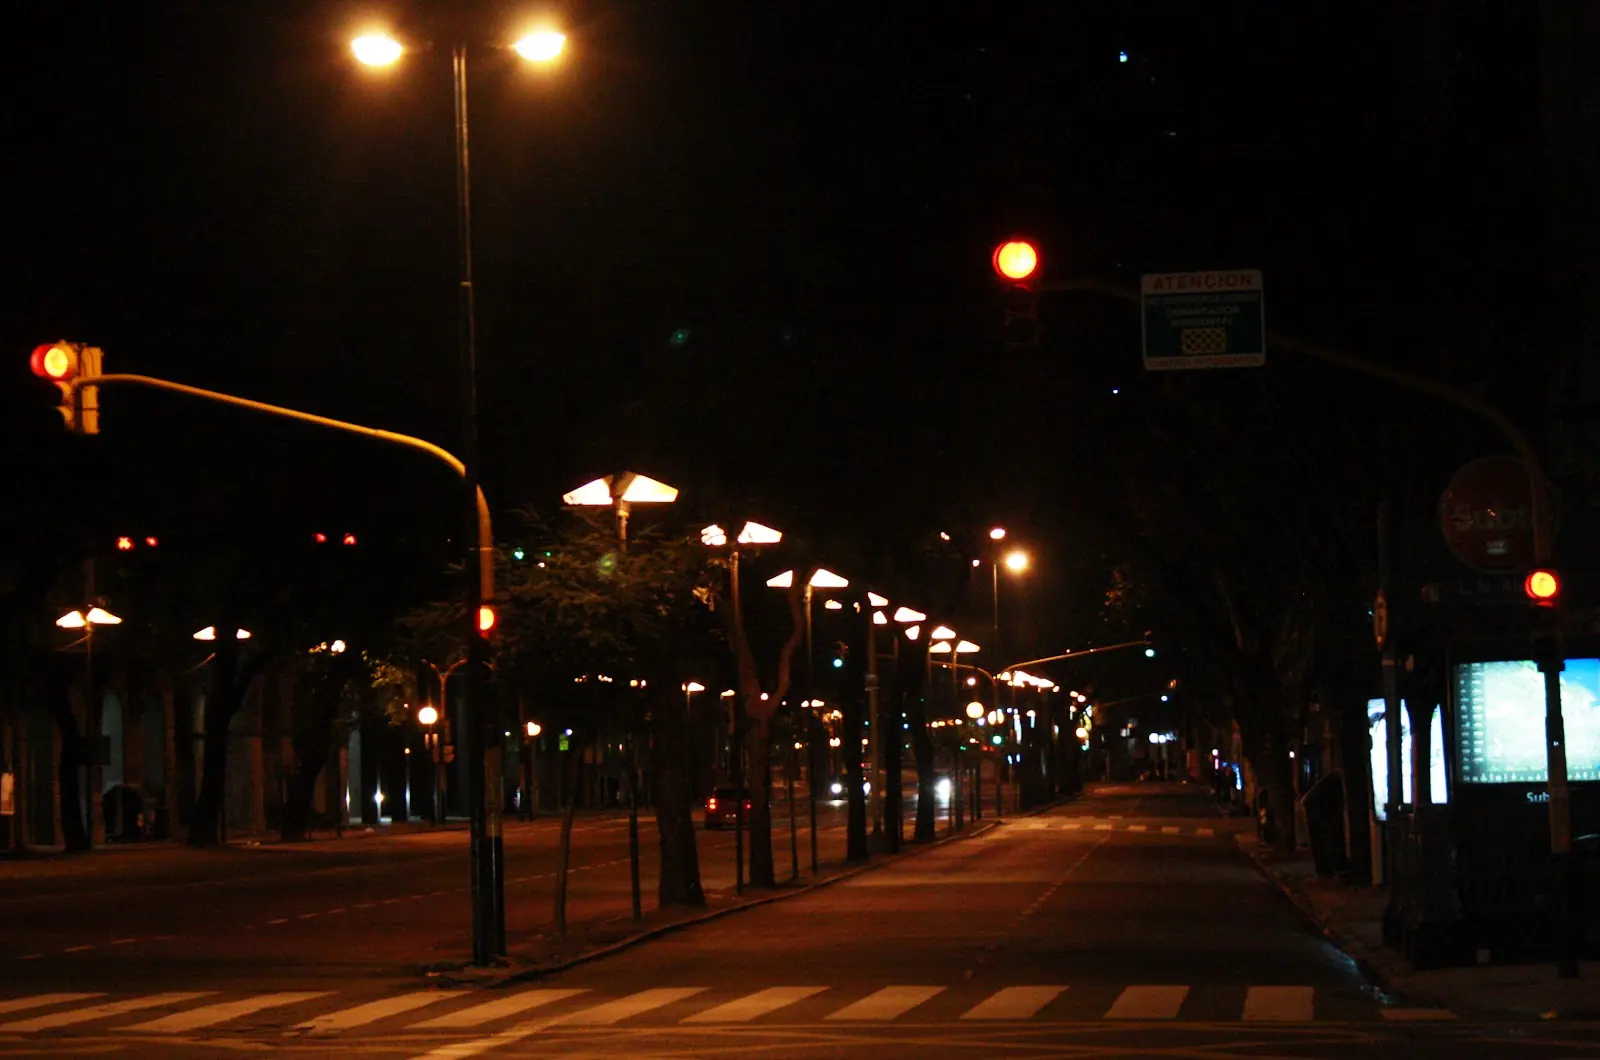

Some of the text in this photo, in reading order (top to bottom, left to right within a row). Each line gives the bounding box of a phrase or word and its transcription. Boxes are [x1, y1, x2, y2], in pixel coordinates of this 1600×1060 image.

[1153, 273, 1253, 290] ATENCION
[1453, 502, 1528, 531] Subt
[1526, 791, 1550, 803] Sub
